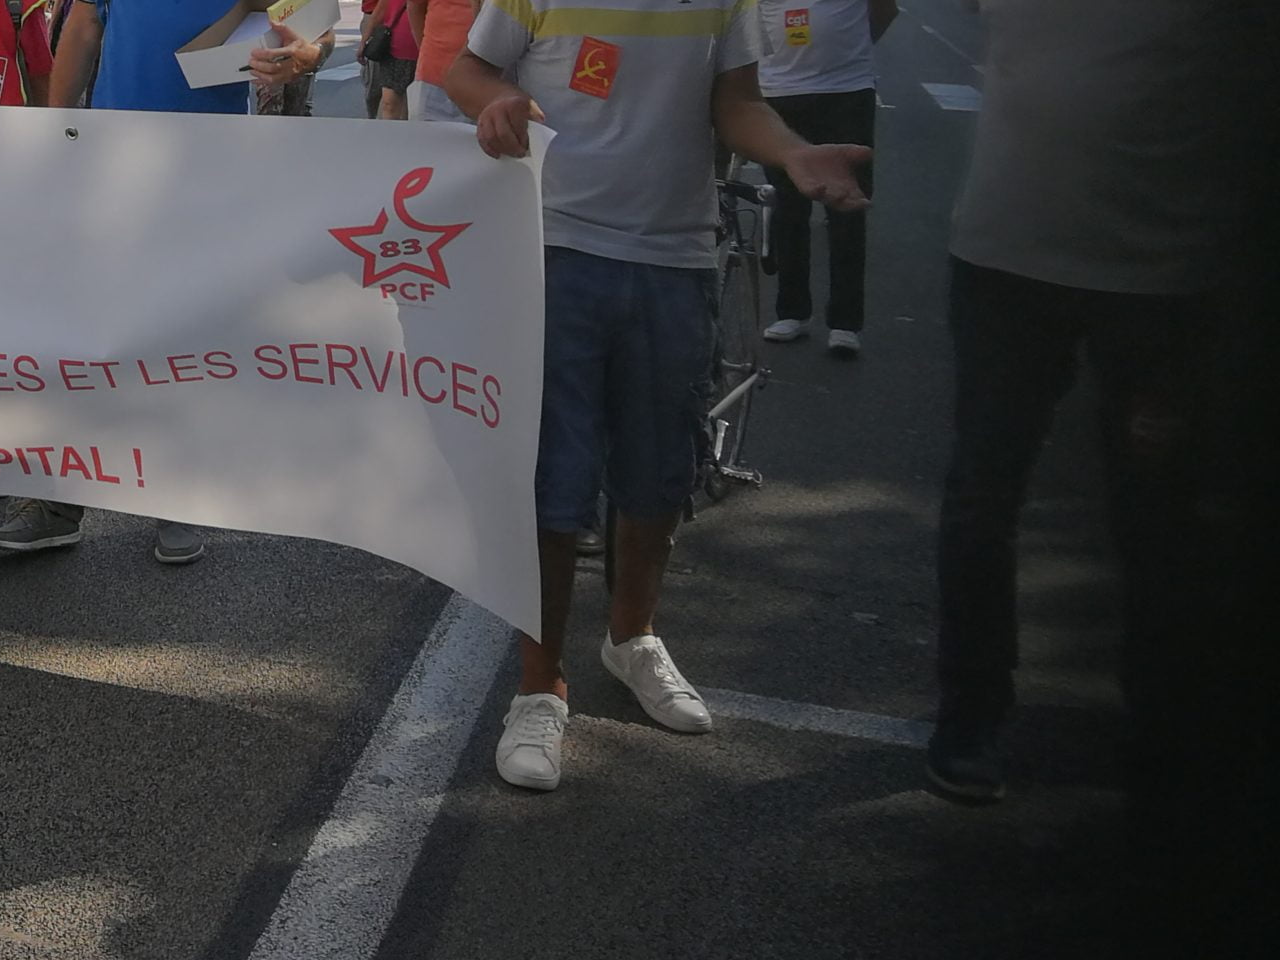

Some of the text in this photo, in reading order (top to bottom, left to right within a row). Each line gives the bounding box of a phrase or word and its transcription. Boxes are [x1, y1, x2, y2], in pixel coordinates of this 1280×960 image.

[786, 14, 808, 26] cgt
[379, 239, 422, 258] 83
[380, 282, 434, 302] PCF
[59, 359, 120, 391] ET
[137, 351, 238, 385] LES
[253, 343, 502, 429] SERVICES
